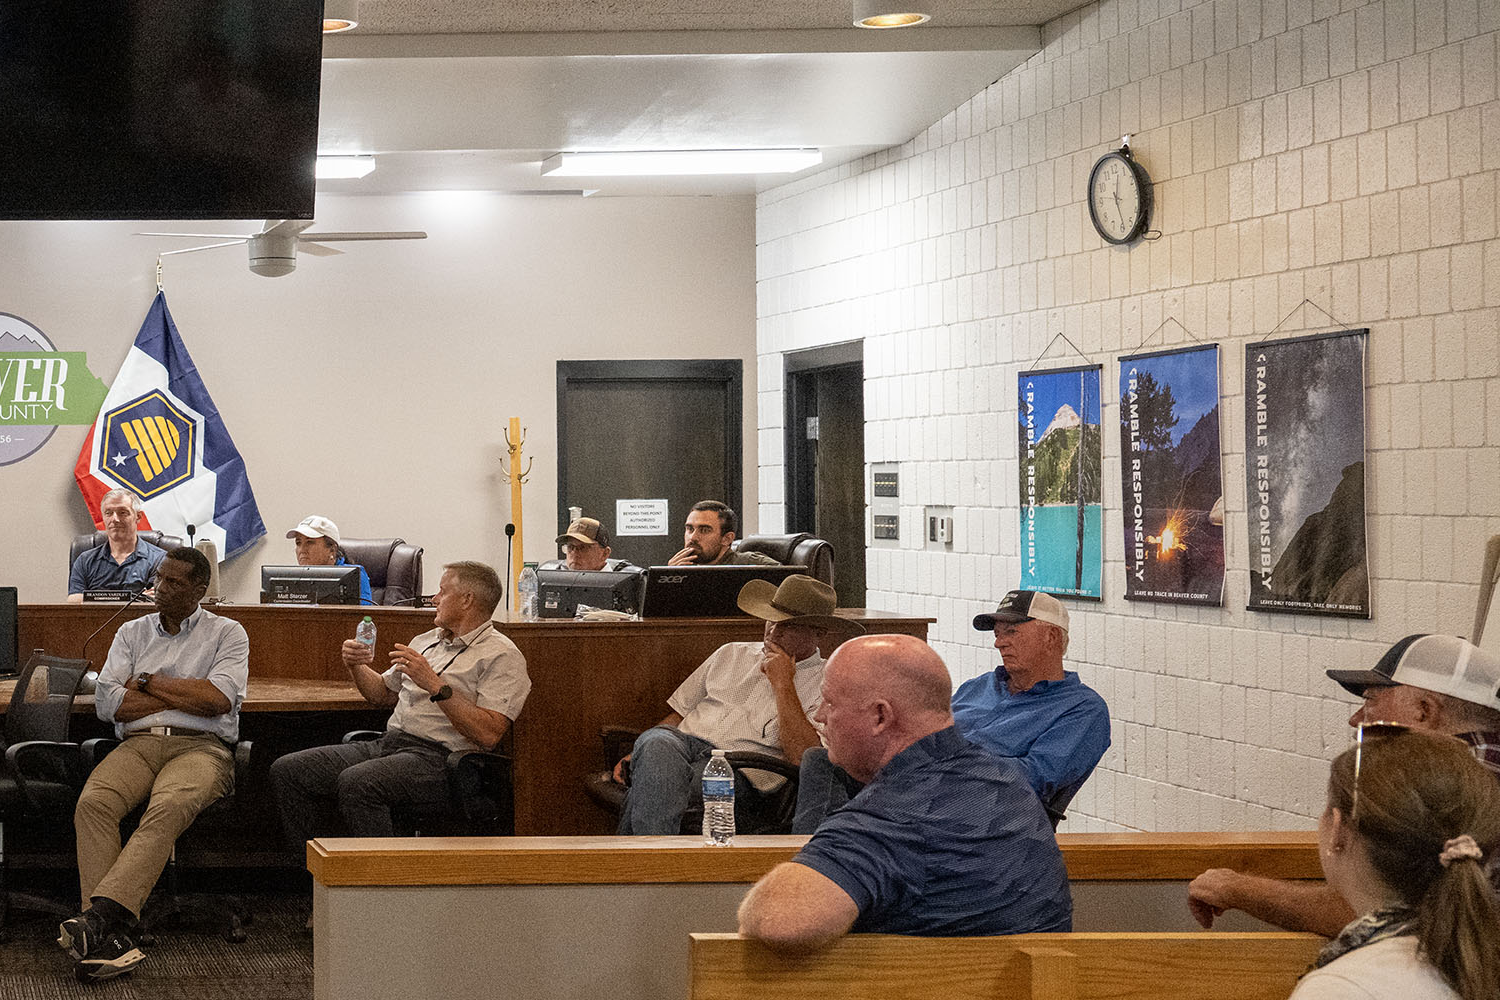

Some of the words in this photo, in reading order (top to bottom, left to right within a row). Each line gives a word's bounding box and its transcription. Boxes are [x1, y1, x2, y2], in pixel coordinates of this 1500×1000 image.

[1027, 392, 1035, 459] RAMBLE
[1129, 379, 1140, 452] RAMBLE
[1256, 366, 1268, 447] RAMBLE
[1027, 465, 1036, 577] RESPONSIBLY
[1132, 459, 1144, 582] RESPONSIBLY
[1257, 455, 1272, 591] RESPONSIBLY
[658, 575, 688, 584] acer
